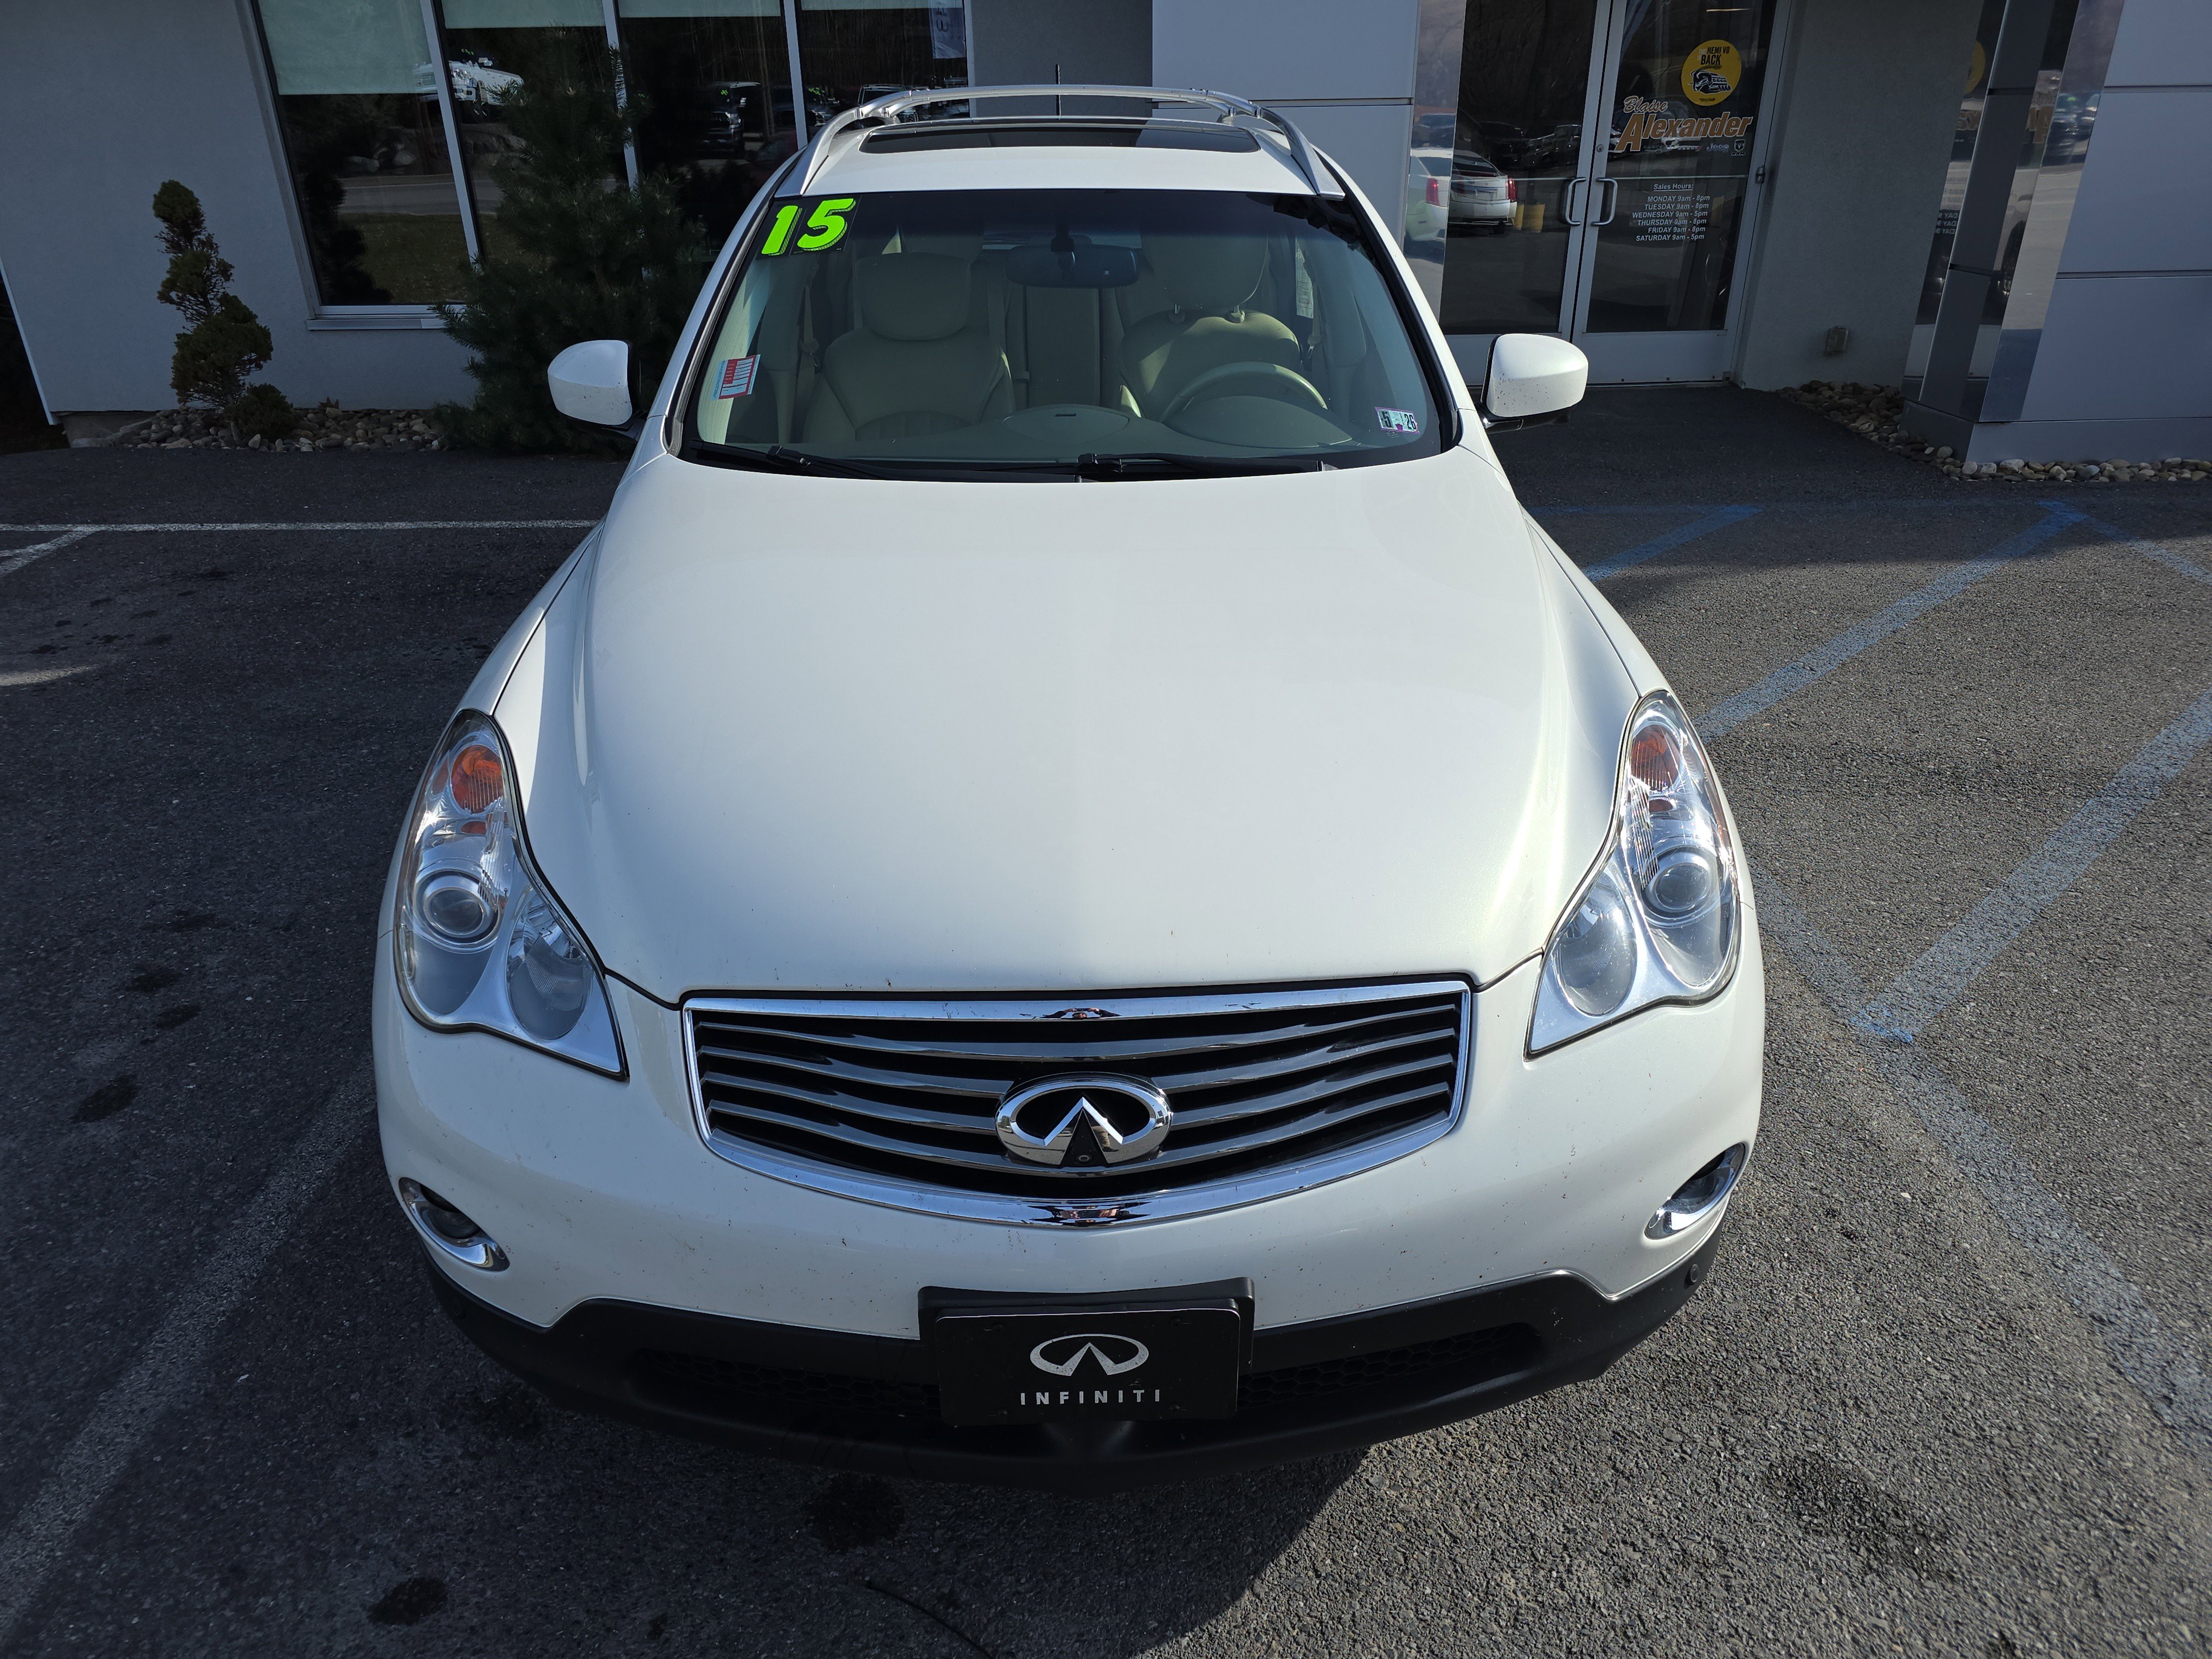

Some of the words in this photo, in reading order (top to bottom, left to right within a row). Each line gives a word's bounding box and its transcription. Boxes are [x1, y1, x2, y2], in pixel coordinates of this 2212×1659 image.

[1701, 55, 1721, 65] BACK
[1624, 95, 1668, 113] Blaise
[1614, 112, 1753, 152] Alexander
[1707, 142, 1729, 152] Jeep
[761, 198, 856, 256] 15
[1404, 414, 1416, 429] 26
[1020, 1390, 1160, 1405] INFINITI
